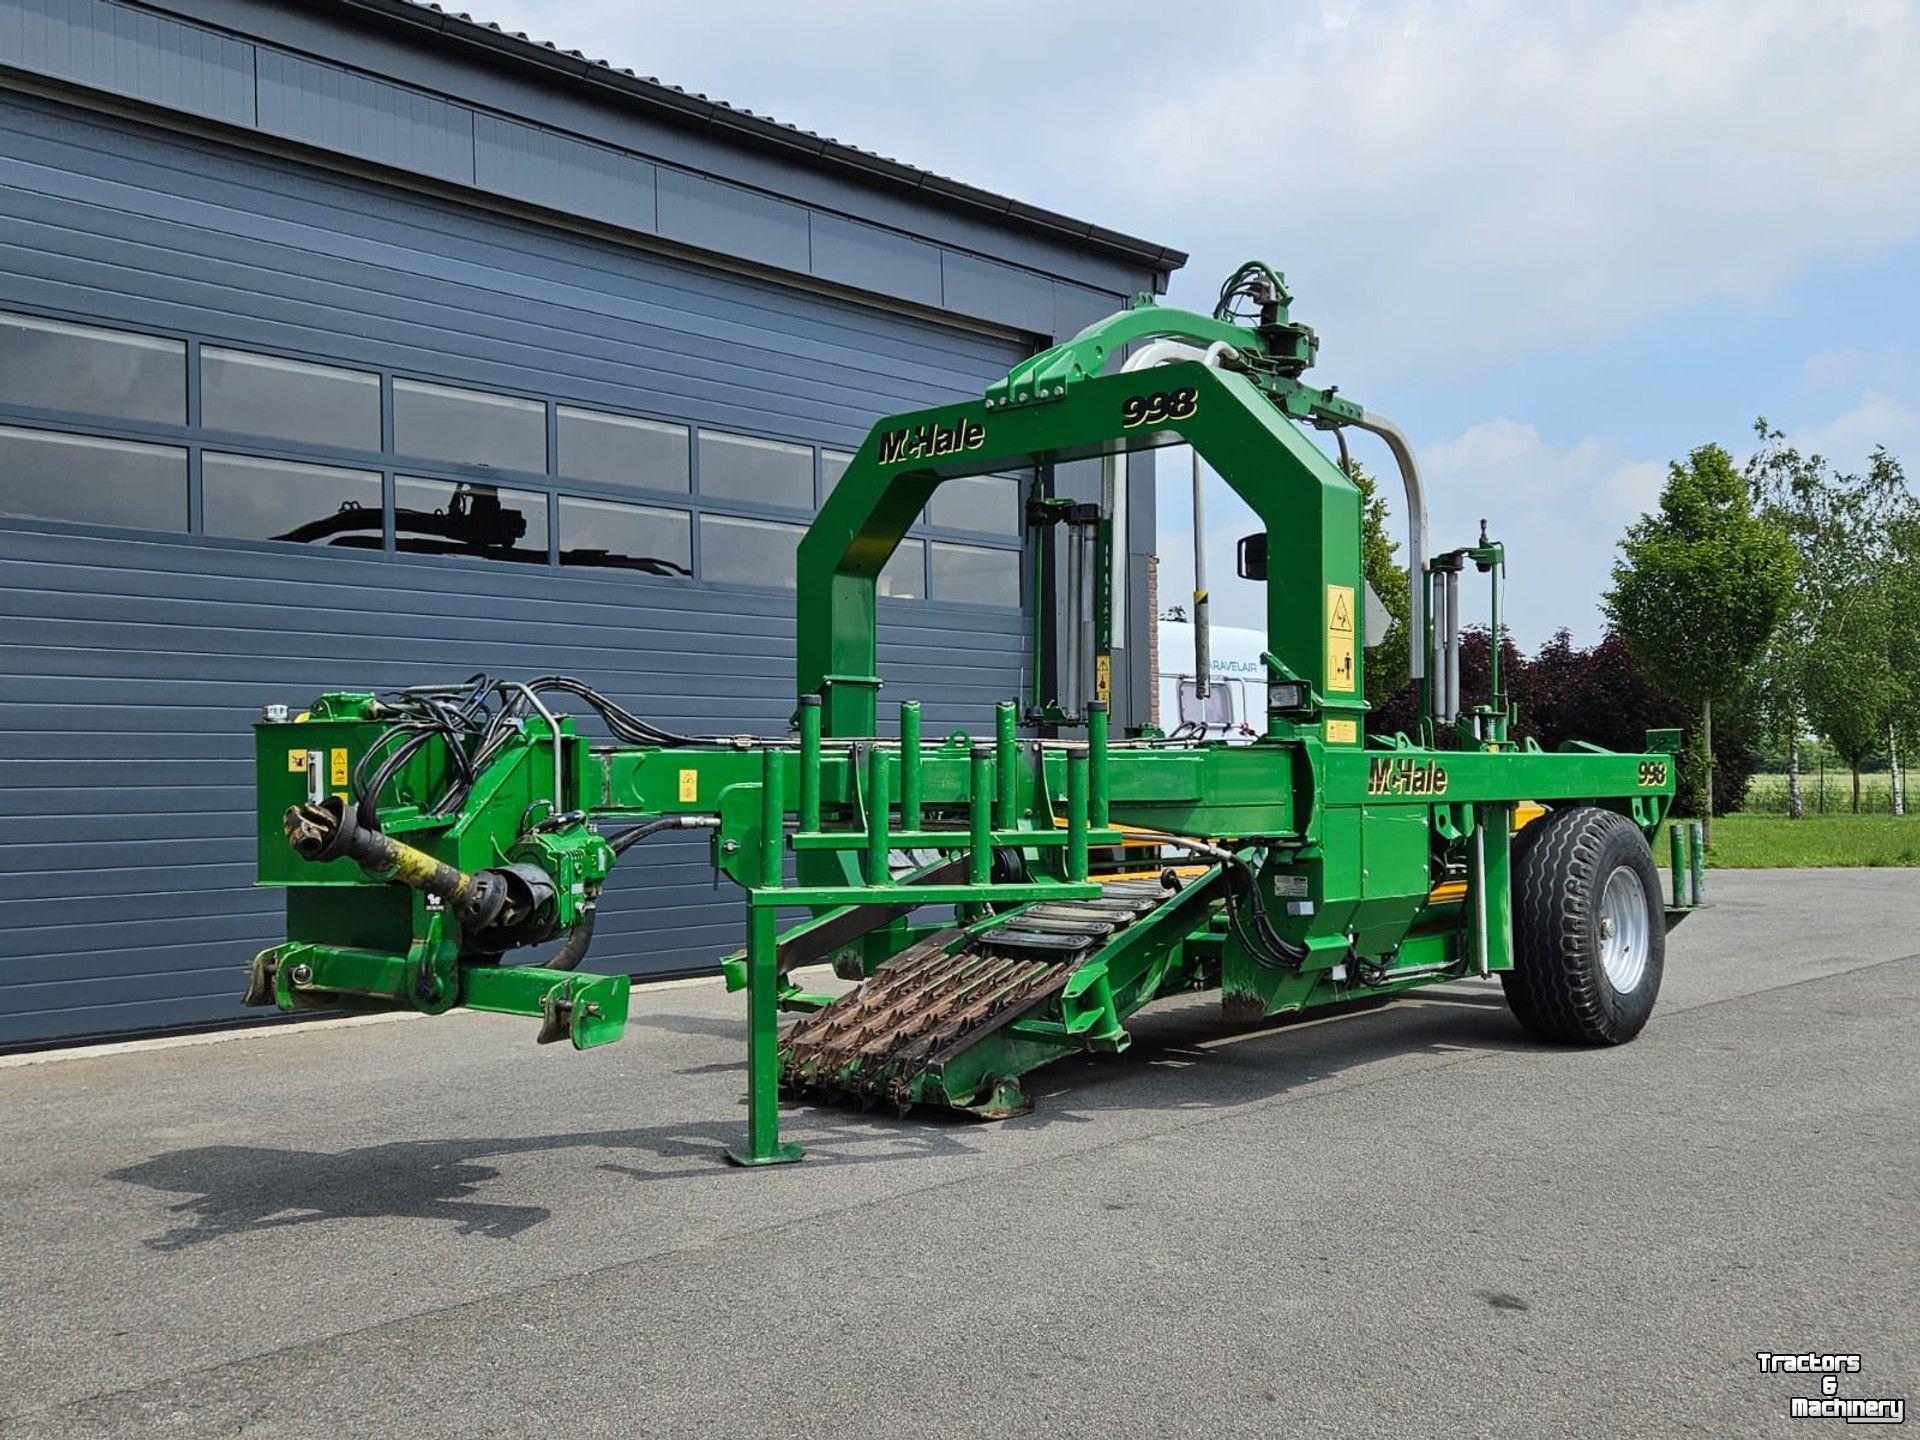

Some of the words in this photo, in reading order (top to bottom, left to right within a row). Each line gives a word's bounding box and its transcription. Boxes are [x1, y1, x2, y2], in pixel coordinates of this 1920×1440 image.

[1121, 387, 1199, 429] 998
[878, 418, 985, 466] McHale
[1368, 757, 1448, 795] McHale
[1638, 761, 1667, 787] 998
